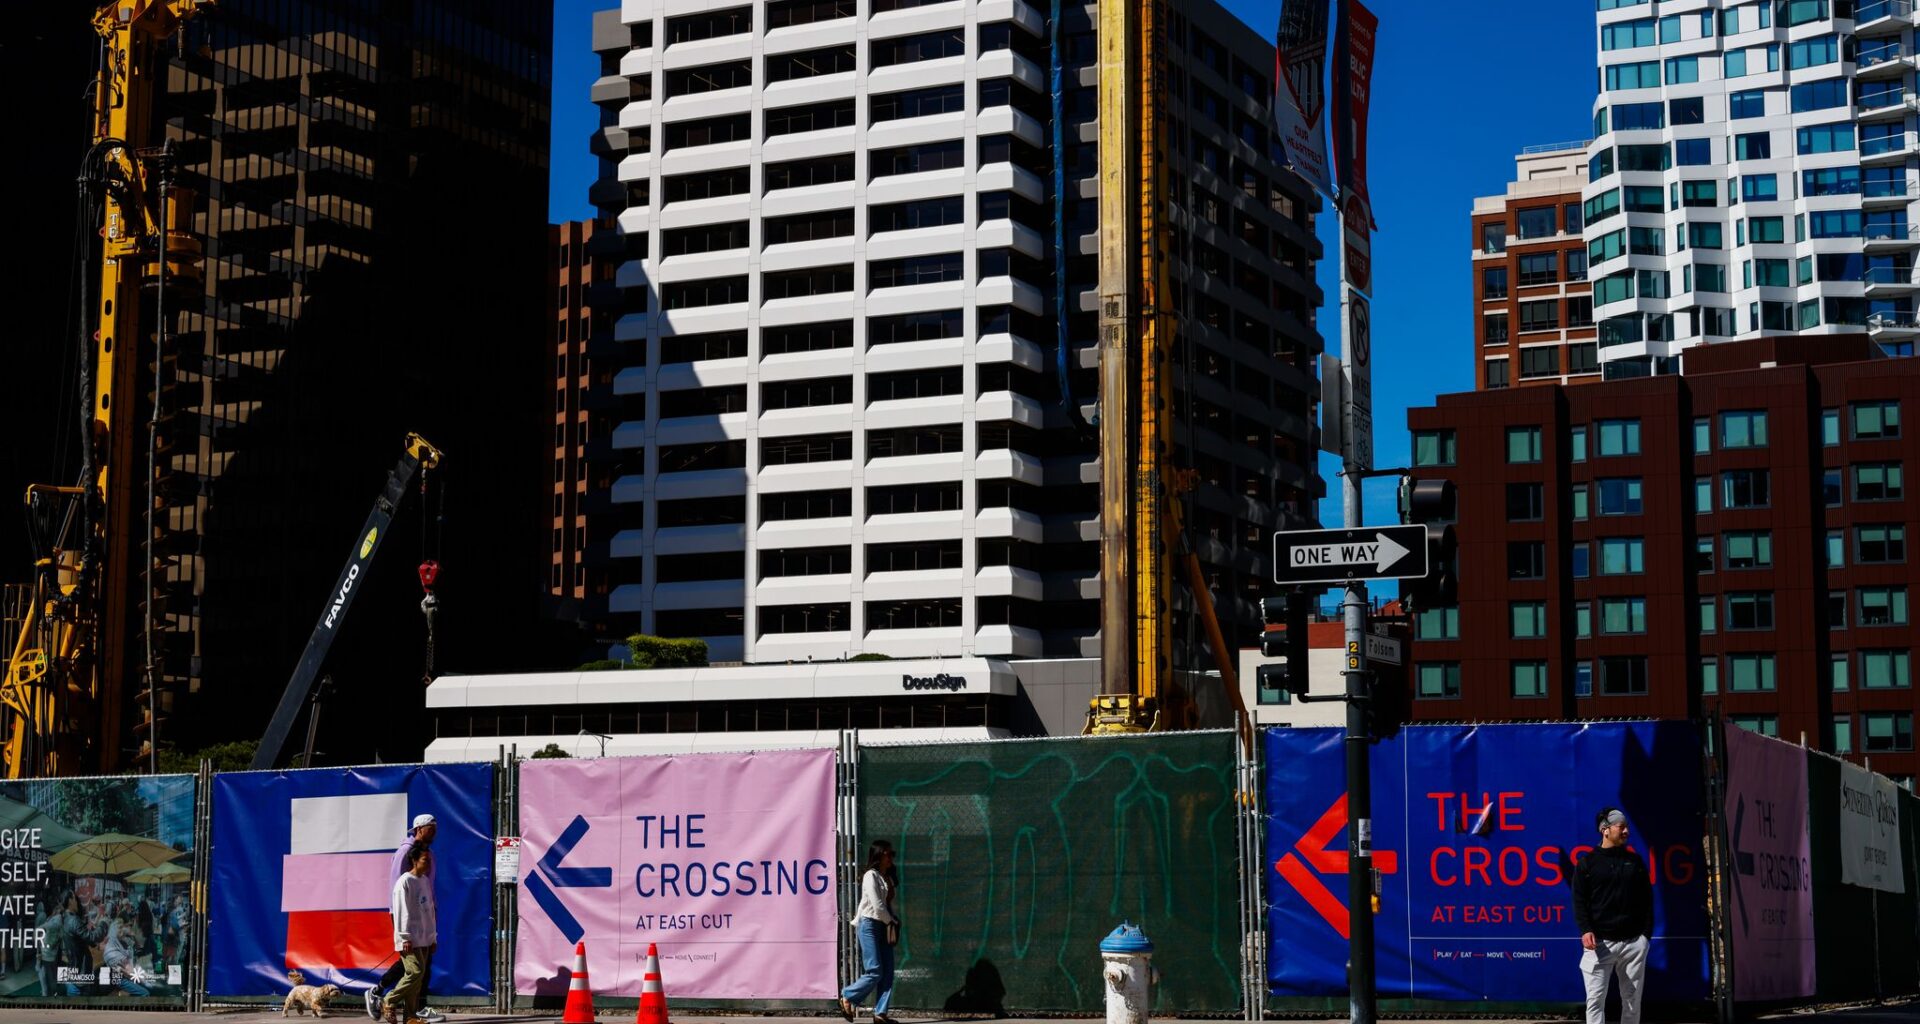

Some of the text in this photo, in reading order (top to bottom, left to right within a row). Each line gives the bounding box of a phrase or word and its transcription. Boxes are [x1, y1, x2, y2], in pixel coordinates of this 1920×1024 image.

[1294, 125, 1308, 142] OUR
[1295, 544, 1379, 564] ONE WAY
[325, 564, 360, 629] FAVCO
[1369, 639, 1395, 657] Folsom
[902, 673, 967, 692] DocuSign
[1428, 791, 1525, 833] THE
[0, 828, 42, 849] GIZE
[636, 814, 706, 849] THE
[1, 861, 49, 885] SELF,
[636, 859, 829, 897] CROSSING
[0, 895, 35, 915] ATE
[1432, 905, 1565, 923] AT EAST CUT
[636, 914, 733, 930] AT EAST CUT
[67, 973, 96, 981] FRANCISCO
